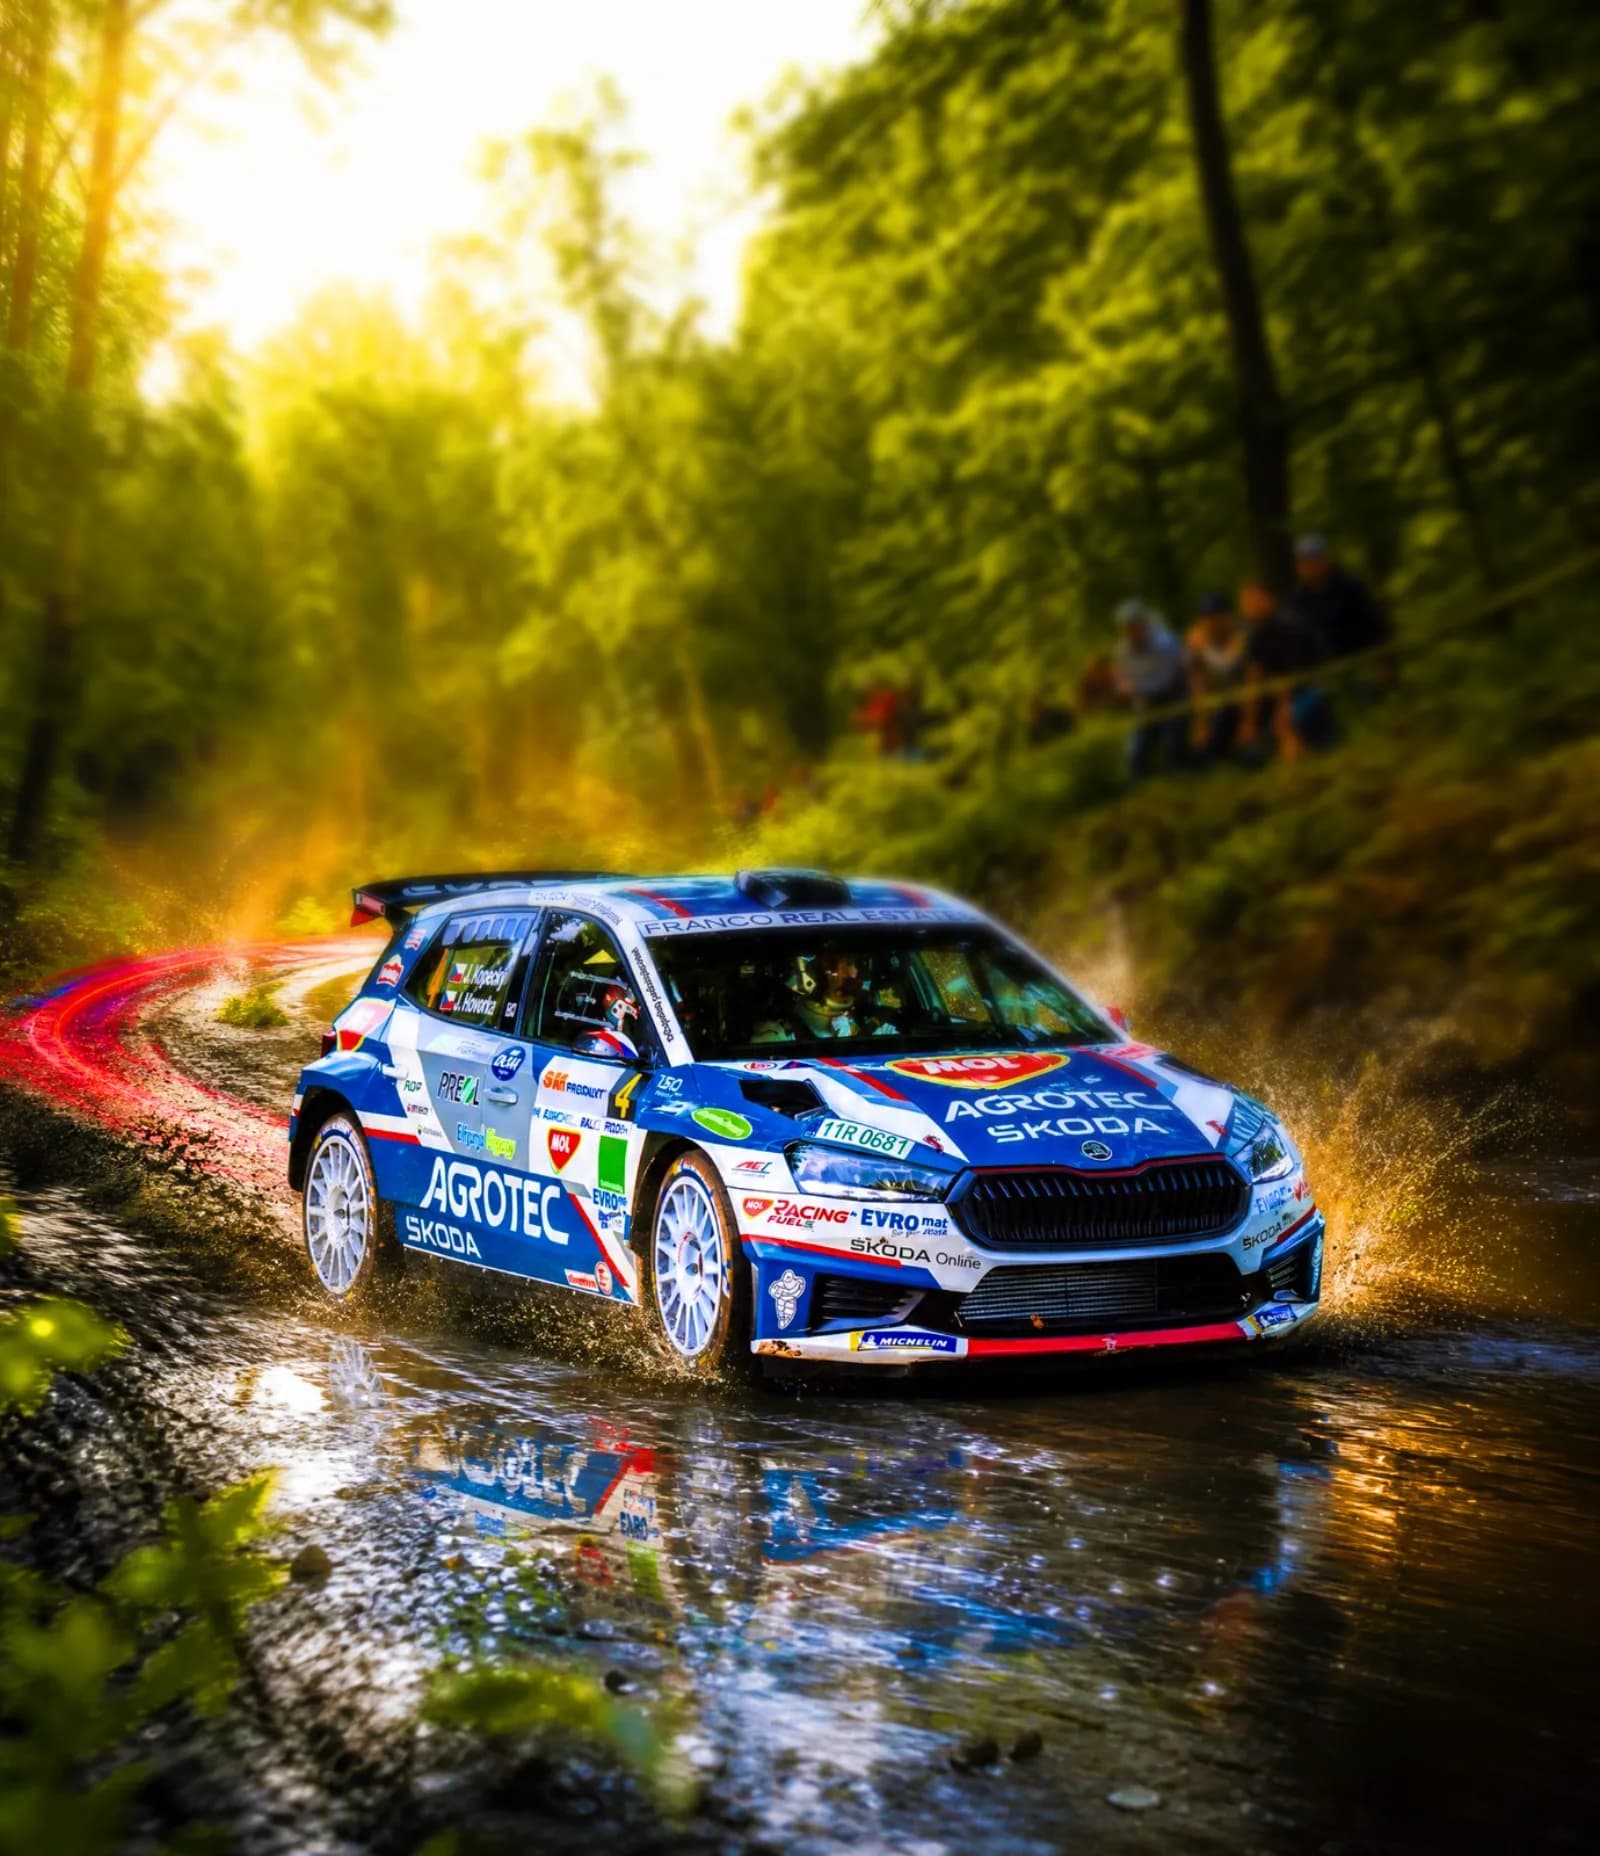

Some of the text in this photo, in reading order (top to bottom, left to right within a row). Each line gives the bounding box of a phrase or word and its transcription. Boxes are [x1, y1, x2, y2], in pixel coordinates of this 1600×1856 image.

[644, 911, 773, 935] FRANCO
[779, 908, 856, 924] REAL
[922, 1056, 1021, 1075] MOL
[614, 1072, 643, 1119] 4
[944, 1091, 1173, 1123] AGROTEC
[550, 1132, 571, 1154] MOL
[823, 1121, 909, 1155] 11R 0681
[419, 1155, 569, 1246] AGROTEC
[773, 1199, 850, 1224] RACING
[766, 1214, 815, 1230] FUELS
[860, 1207, 949, 1231] EVRO mat
[935, 1251, 981, 1270] Online
[879, 1337, 948, 1348] MICHELIN
